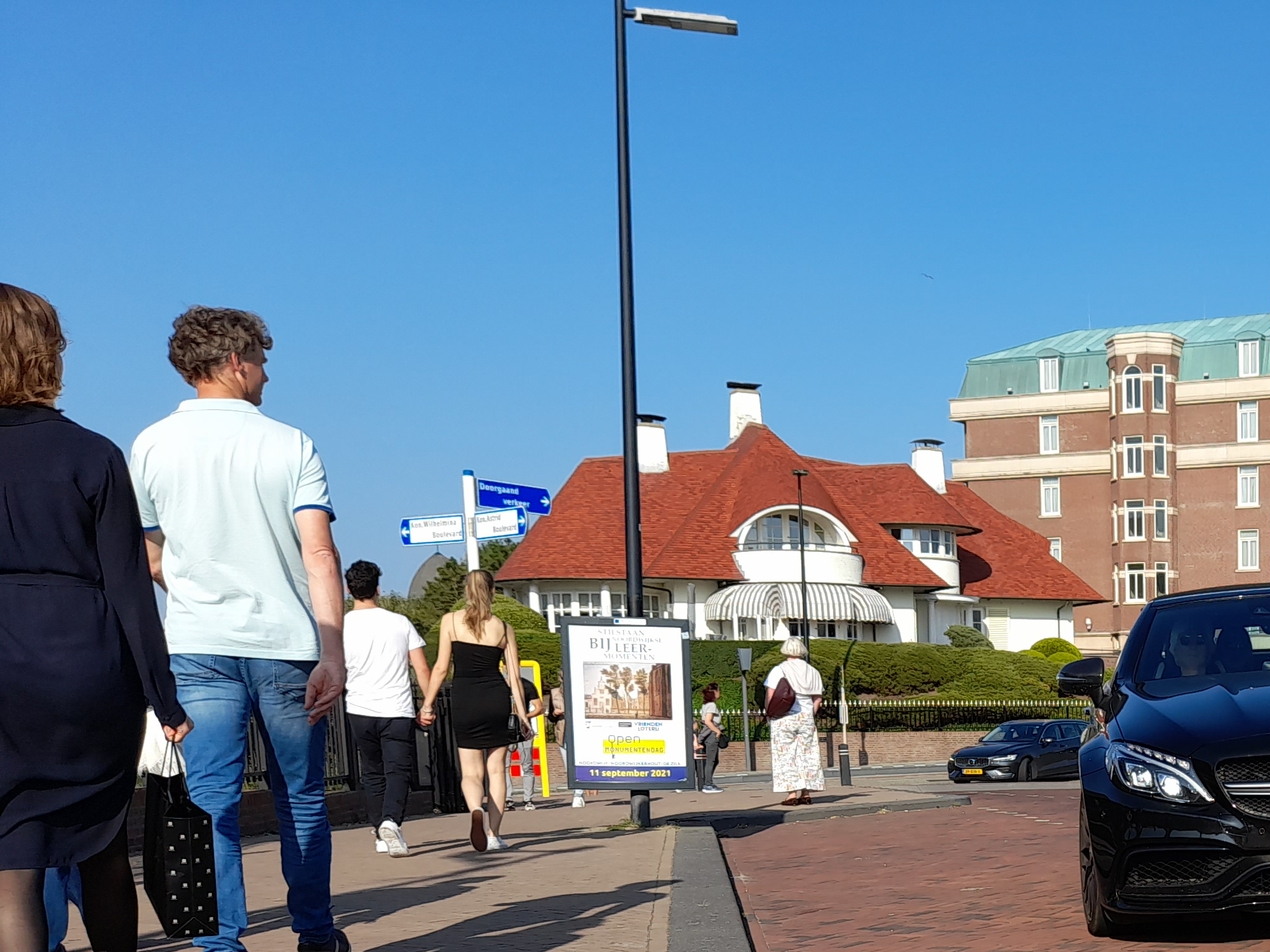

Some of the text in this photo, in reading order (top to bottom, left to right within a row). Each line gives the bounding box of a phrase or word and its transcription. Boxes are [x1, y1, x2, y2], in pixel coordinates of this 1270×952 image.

[479, 481, 520, 496] Doorgaand
[502, 497, 531, 508] verkeer
[424, 519, 457, 528] Wilhelmina
[492, 524, 517, 533] Boulevard
[432, 529, 463, 539] Boulevard
[589, 637, 652, 653] BIJ LEER-
[604, 653, 655, 661] MOMENTEN
[608, 734, 641, 746] Open
[604, 746, 664, 754] MONUMENTENDAG
[589, 768, 671, 778] 11 september 2021
